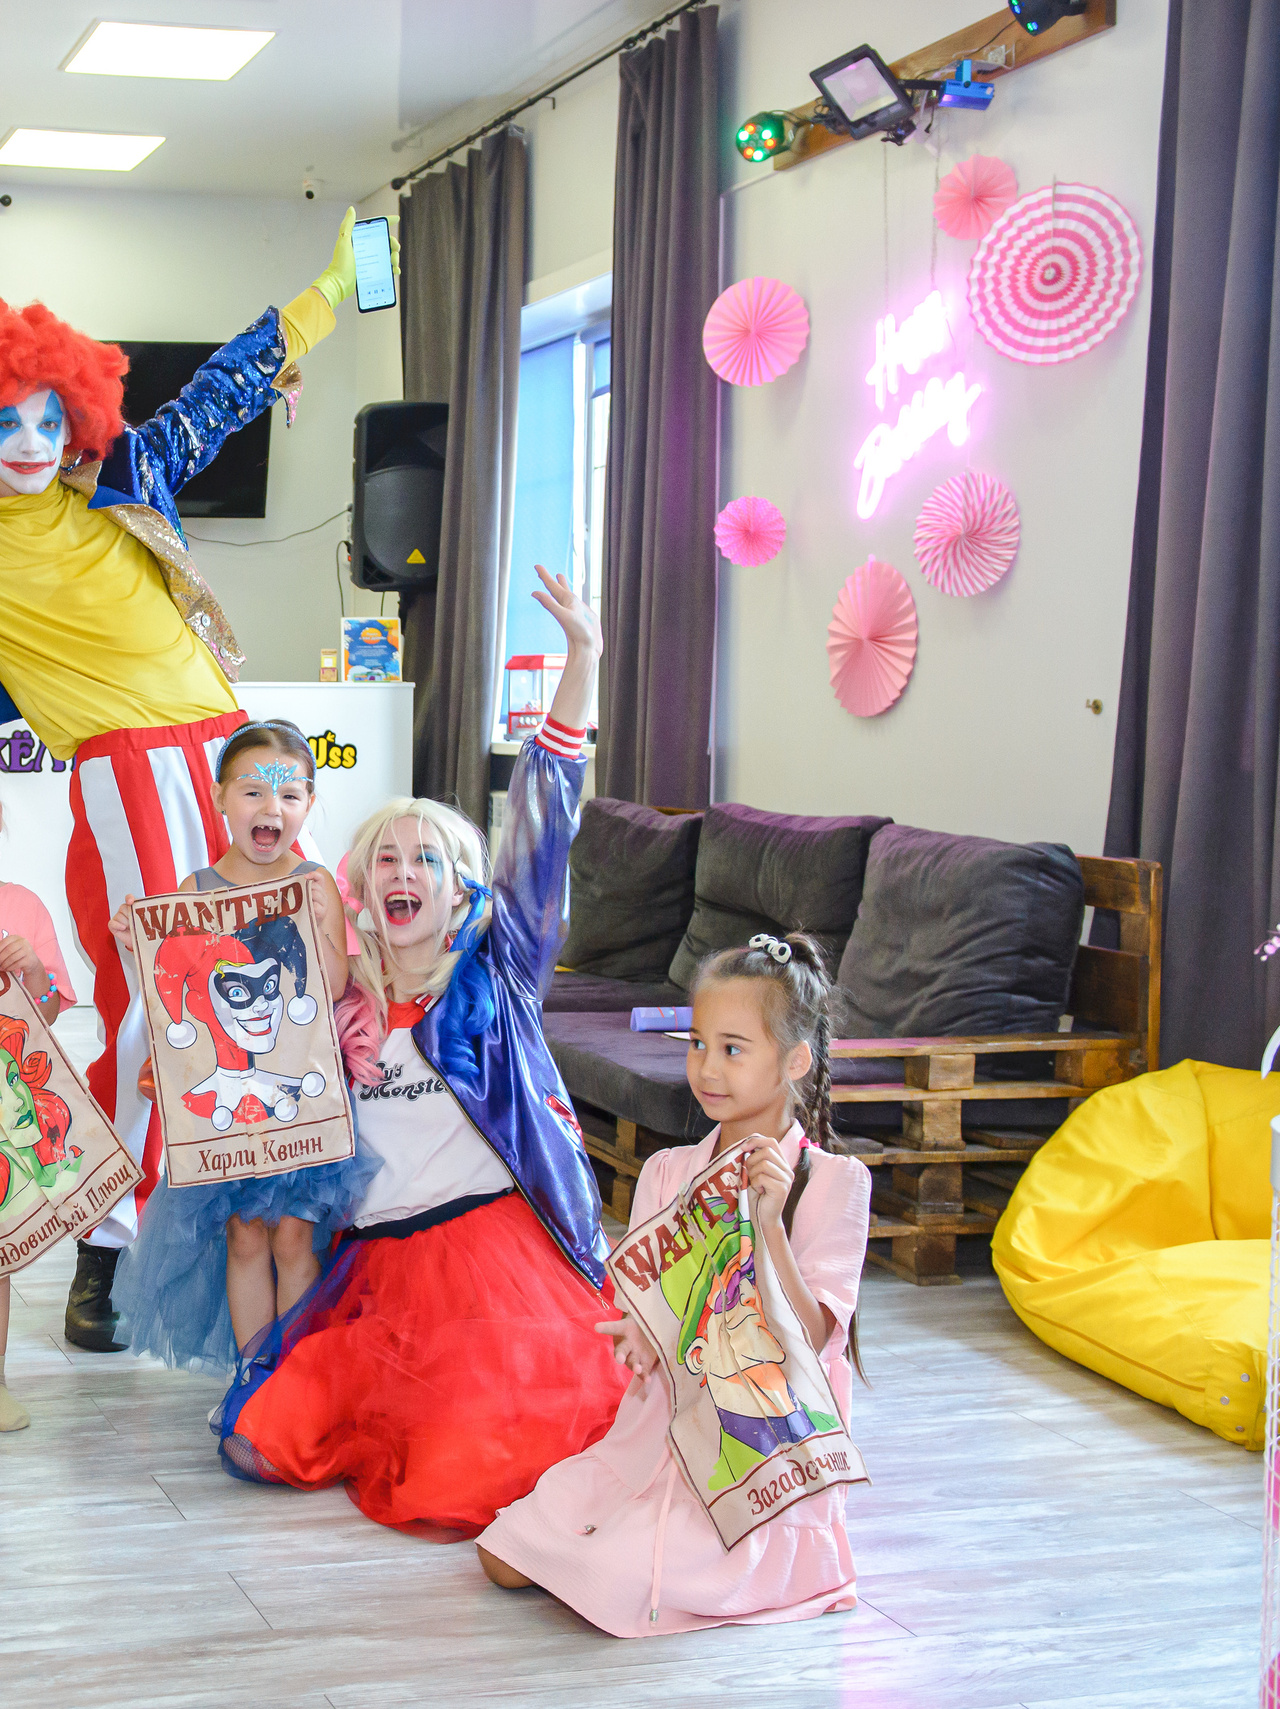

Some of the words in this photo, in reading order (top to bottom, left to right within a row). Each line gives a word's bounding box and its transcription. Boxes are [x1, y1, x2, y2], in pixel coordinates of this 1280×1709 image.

[134, 881, 304, 942] WANTED
[359, 1076, 448, 1101] Monste
[197, 1148, 257, 1176] Харли
[262, 1135, 324, 1165] Квинн
[84, 1164, 135, 1214] Плющ
